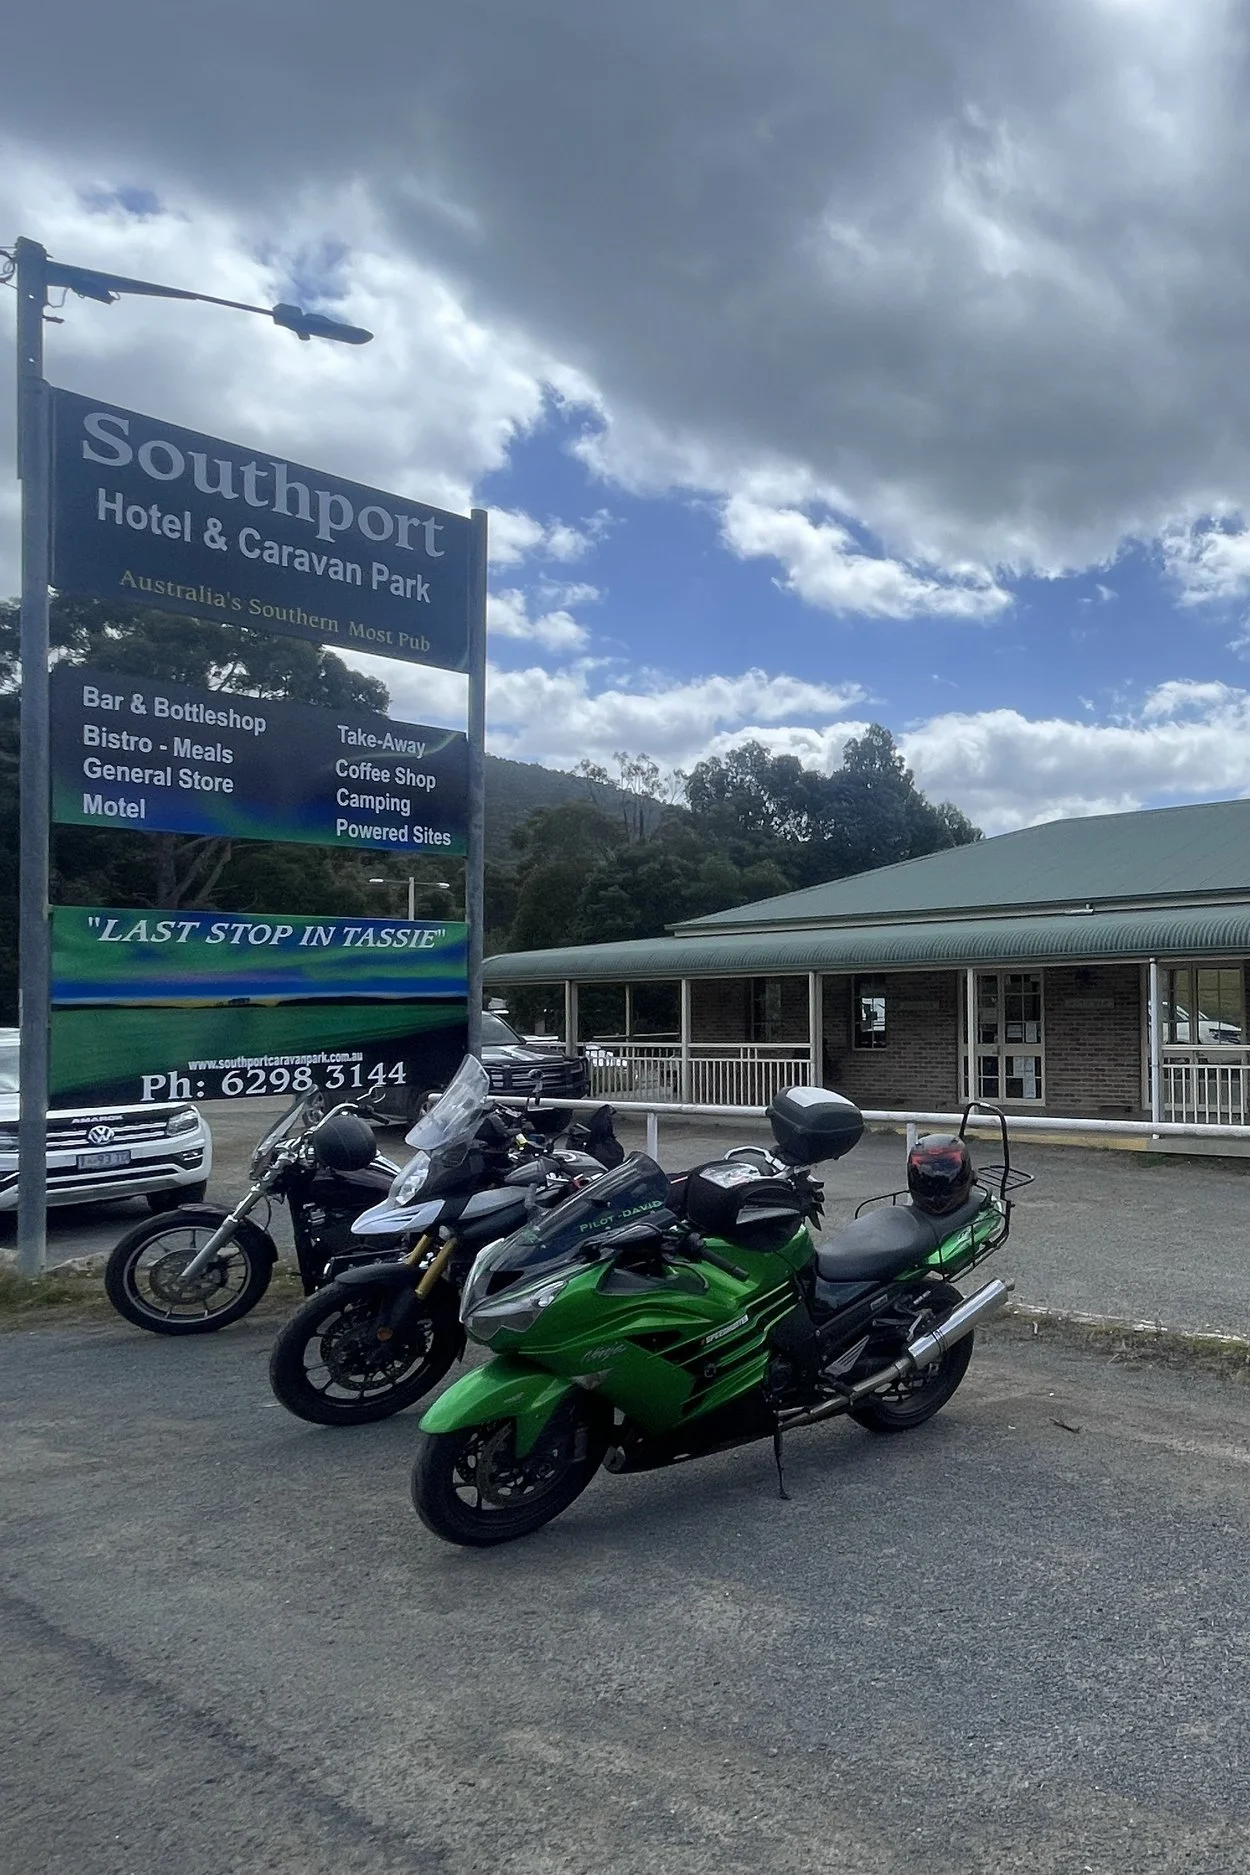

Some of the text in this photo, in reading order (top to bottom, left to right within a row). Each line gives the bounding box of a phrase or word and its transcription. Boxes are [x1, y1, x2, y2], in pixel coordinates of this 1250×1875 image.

[82, 412, 446, 557] Southport
[98, 487, 431, 603] Hotel & Caravan Park
[120, 570, 431, 652] Australia's Southern Most Pub
[83, 685, 267, 736] Bar & Bottleshop
[83, 724, 153, 753] Bistro
[173, 736, 234, 764] Meals
[337, 724, 425, 759] Take-Away
[83, 757, 234, 793] General Store
[335, 759, 437, 792] Coffee Shop
[83, 793, 146, 819] Motel
[336, 788, 411, 817] Camping
[336, 818, 452, 846] Powered Sites
[88, 916, 446, 949] "LAST STOP IN TASSIE"
[188, 1051, 363, 1070] www.southportcaravanpark.com.au
[140, 1061, 407, 1101] Ph: 6298 3144
[579, 1215, 614, 1232] PILOT
